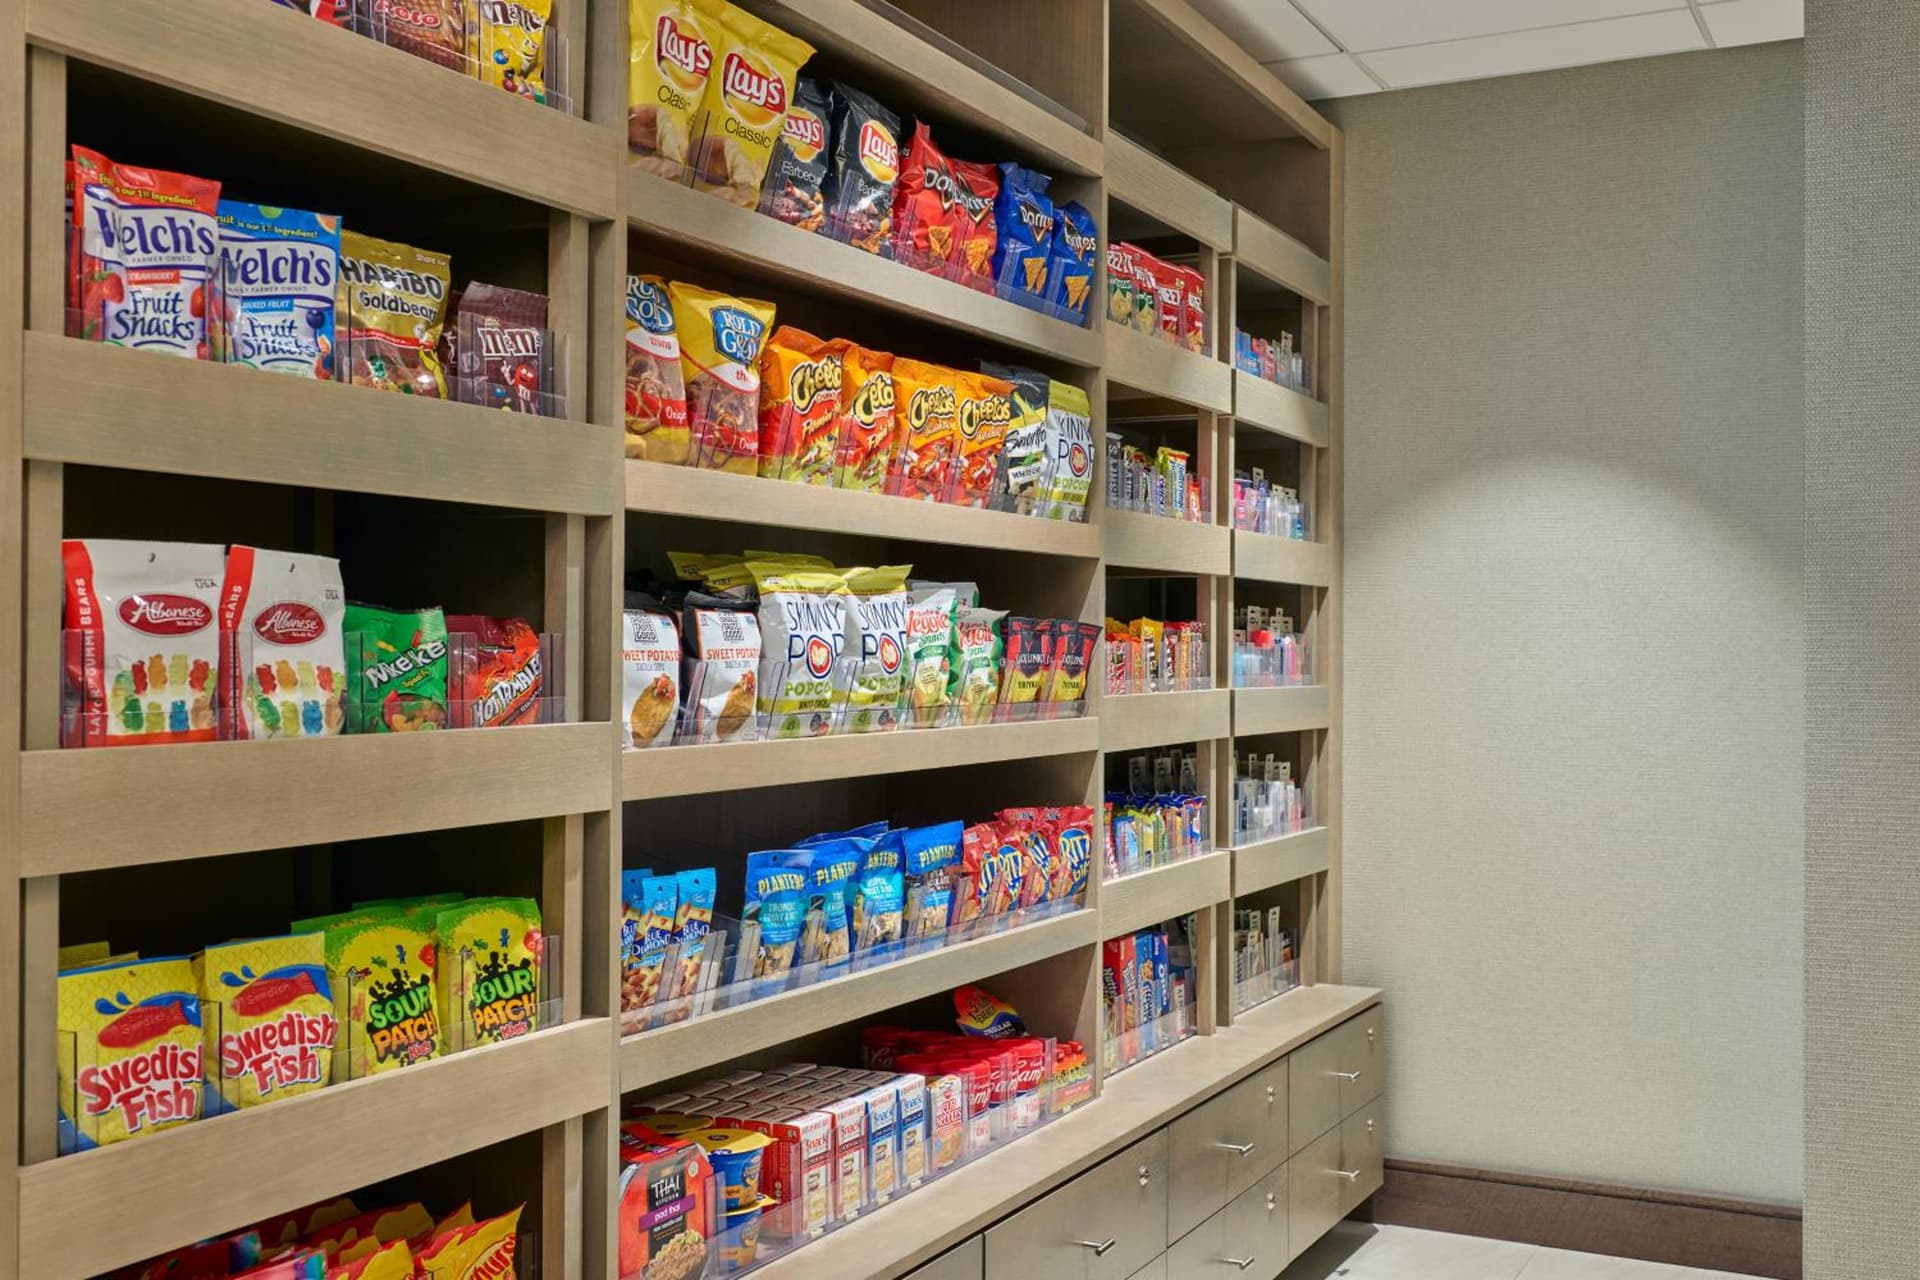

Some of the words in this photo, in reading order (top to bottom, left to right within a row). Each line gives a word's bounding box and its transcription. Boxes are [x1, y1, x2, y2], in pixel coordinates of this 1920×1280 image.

[661, 18, 711, 73] Lay's
[726, 55, 785, 107] Lay's
[724, 117, 772, 149] Classic
[782, 116, 822, 145] ay's
[863, 126, 898, 166] Lay's
[216, 215, 234, 225] ruit
[130, 290, 183, 316] Fruit
[112, 308, 195, 341] Snacks
[791, 355, 842, 413] Cheeto
[75, 577, 92, 625] BEARS
[130, 595, 205, 624] Albanese
[786, 600, 841, 632] SKINNY
[260, 609, 319, 633] Albanese
[906, 610, 949, 637] Veggie
[623, 650, 645, 661] WEET
[707, 648, 734, 660] SWEET
[736, 648, 760, 659] POTAT
[816, 862, 858, 887] PLANTE
[864, 851, 898, 870] ANTERS
[473, 968, 534, 1007] SOUR
[370, 985, 430, 1029] SOUR
[473, 993, 536, 1036] PATCH
[221, 1013, 337, 1076] Swedish
[372, 1012, 437, 1059] PATCH
[252, 1047, 319, 1093] Fish
[118, 1082, 196, 1131] Fish
[651, 1175, 680, 1199] THAI
